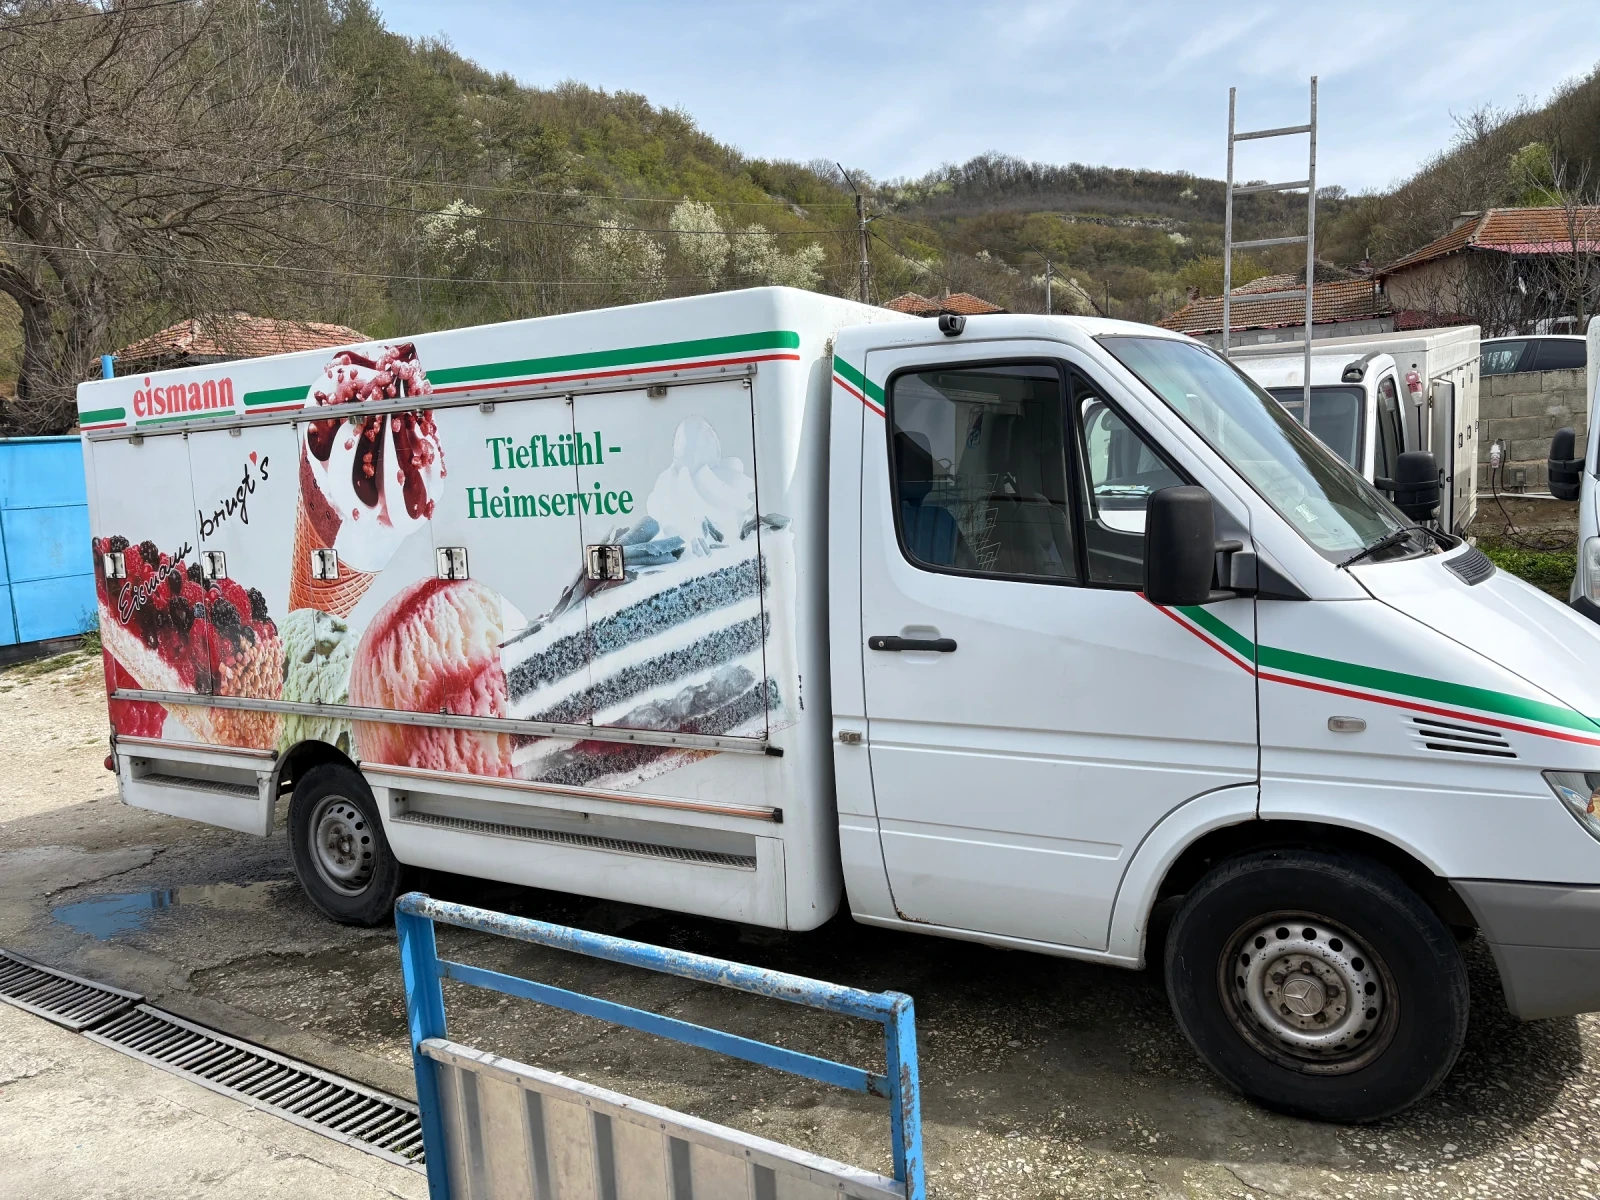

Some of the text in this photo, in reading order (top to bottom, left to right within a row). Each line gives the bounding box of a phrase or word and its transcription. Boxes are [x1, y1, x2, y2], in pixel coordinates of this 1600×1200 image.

[133, 377, 235, 418] eismann
[465, 481, 634, 518] Heimservice
[117, 541, 193, 625] Eismann
